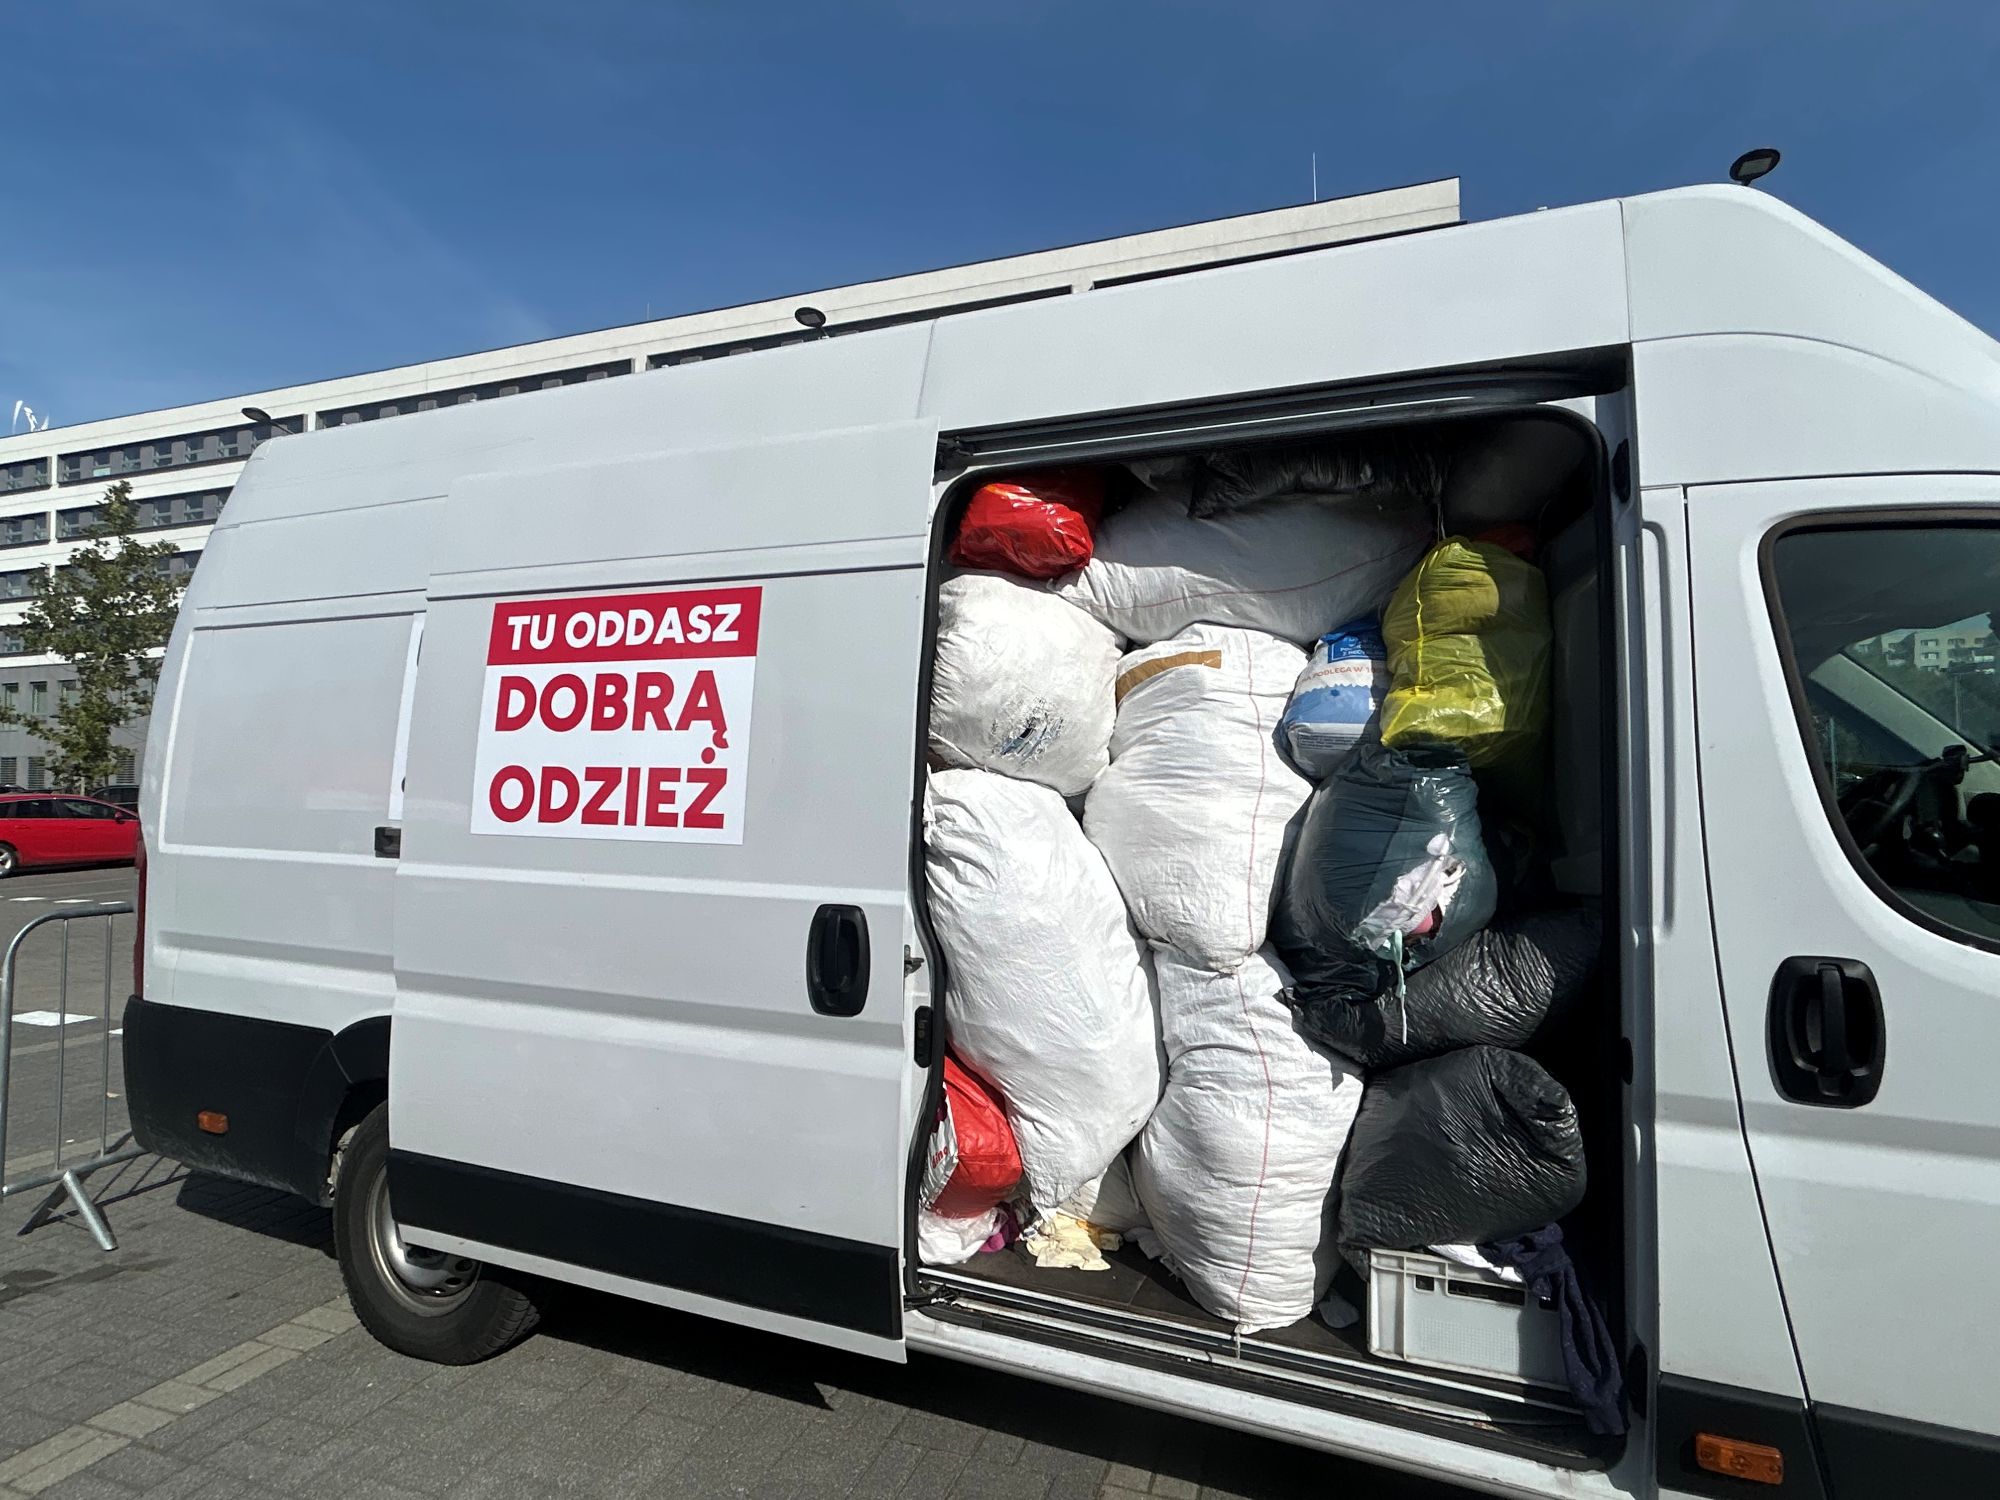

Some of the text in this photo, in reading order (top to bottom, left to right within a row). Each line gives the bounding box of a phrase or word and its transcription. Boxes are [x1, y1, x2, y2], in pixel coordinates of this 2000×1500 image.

[508, 603, 742, 650] TU ODDASZ
[495, 670, 729, 749] DOBRĄ
[489, 747, 728, 829] ODZIEŻ
